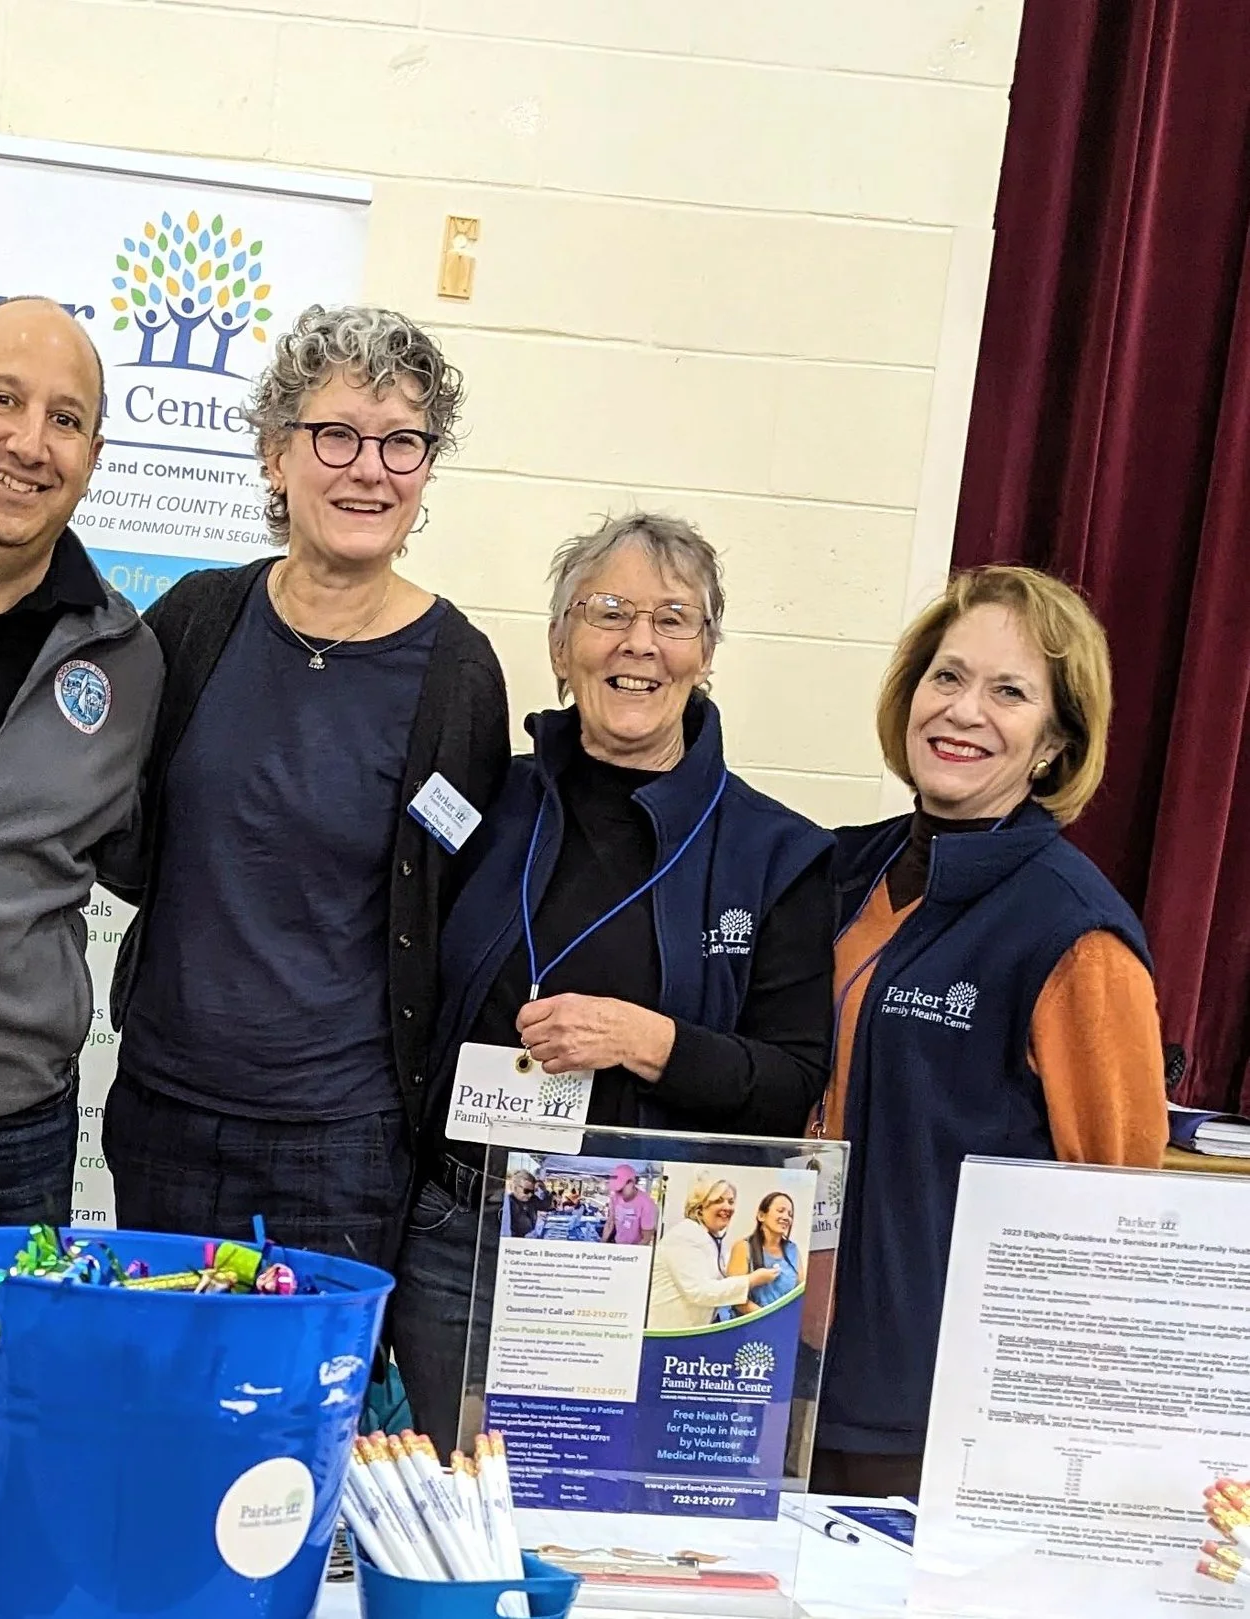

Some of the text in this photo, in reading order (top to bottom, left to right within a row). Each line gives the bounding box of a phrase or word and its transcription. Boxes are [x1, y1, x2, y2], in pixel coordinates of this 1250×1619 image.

[108, 461, 138, 475] and
[84, 488, 229, 518] MOUTH COUNTY
[99, 517, 116, 529] DE
[119, 520, 201, 537] MONMOUTH
[203, 526, 224, 539] SIN
[432, 787, 456, 812] Parker
[883, 985, 944, 1010] Parker
[881, 1004, 973, 1031] Family Health Cente
[457, 1085, 533, 1112] Parker
[454, 1110, 493, 1127] Family
[1118, 1216, 1156, 1228] Parker
[1023, 1229, 1061, 1241] Eligibility
[1123, 1238, 1158, 1248] Services
[1170, 1241, 1198, 1251] Parker
[1199, 1244, 1227, 1254] Family
[1229, 1247, 1250, 1255] Healt
[524, 1249, 538, 1257] Can
[544, 1251, 573, 1259] Become
[582, 1253, 605, 1261] Parker
[608, 1254, 638, 1262] Patient?
[506, 1306, 547, 1315] Questions?
[663, 1356, 732, 1377] Parker
[661, 1378, 772, 1393] Family Health Center
[521, 1401, 559, 1411] Volunteer,
[561, 1404, 590, 1413] Become
[598, 1406, 624, 1415] Patient
[673, 1410, 753, 1423] Free Health Care
[667, 1423, 756, 1436] for People in Need
[680, 1437, 740, 1449] by Volunteer
[657, 1450, 760, 1464] Medical Professionals
[645, 1482, 766, 1496] www.parkerfamilyhealthcenter.org
[673, 1495, 735, 1506] 732-212-0777
[240, 1504, 283, 1519] Parker
